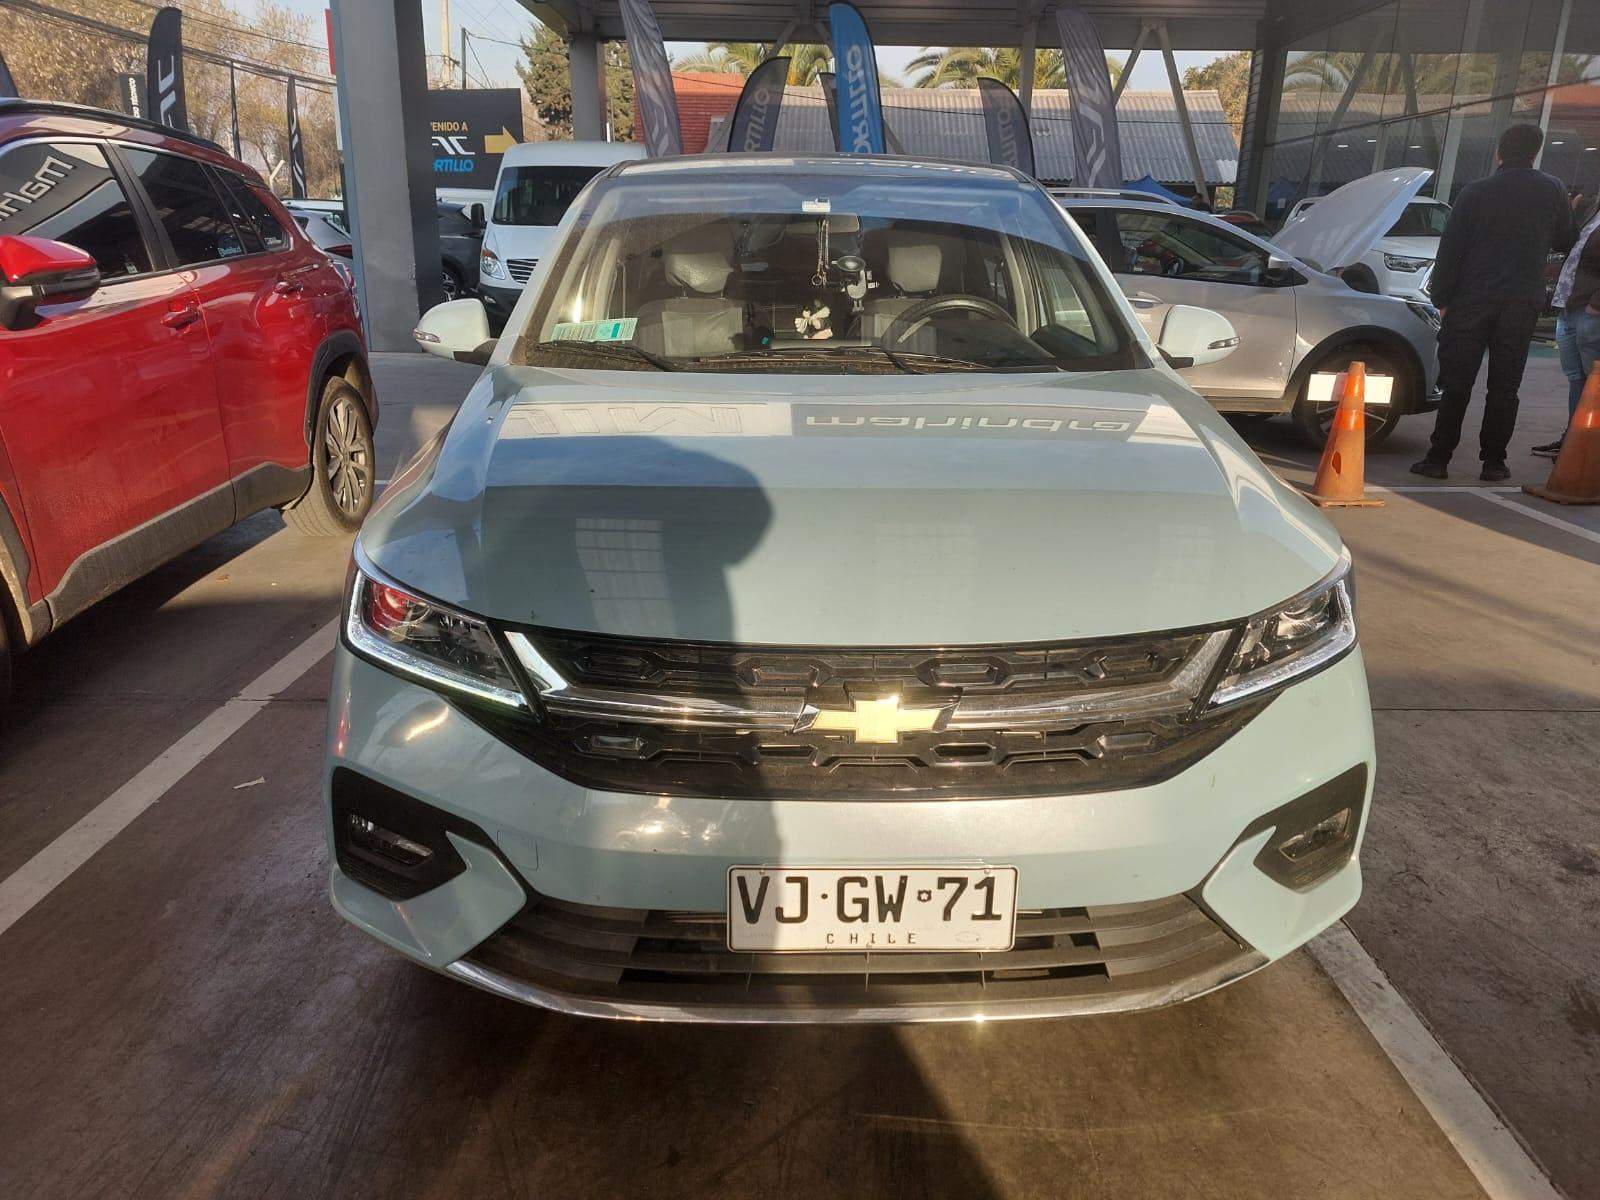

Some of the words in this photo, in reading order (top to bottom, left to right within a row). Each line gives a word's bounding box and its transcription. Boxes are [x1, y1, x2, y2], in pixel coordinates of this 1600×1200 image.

[430, 121, 460, 132] ENIDO
[461, 121, 469, 131] A
[826, 932, 917, 945] CHILE
